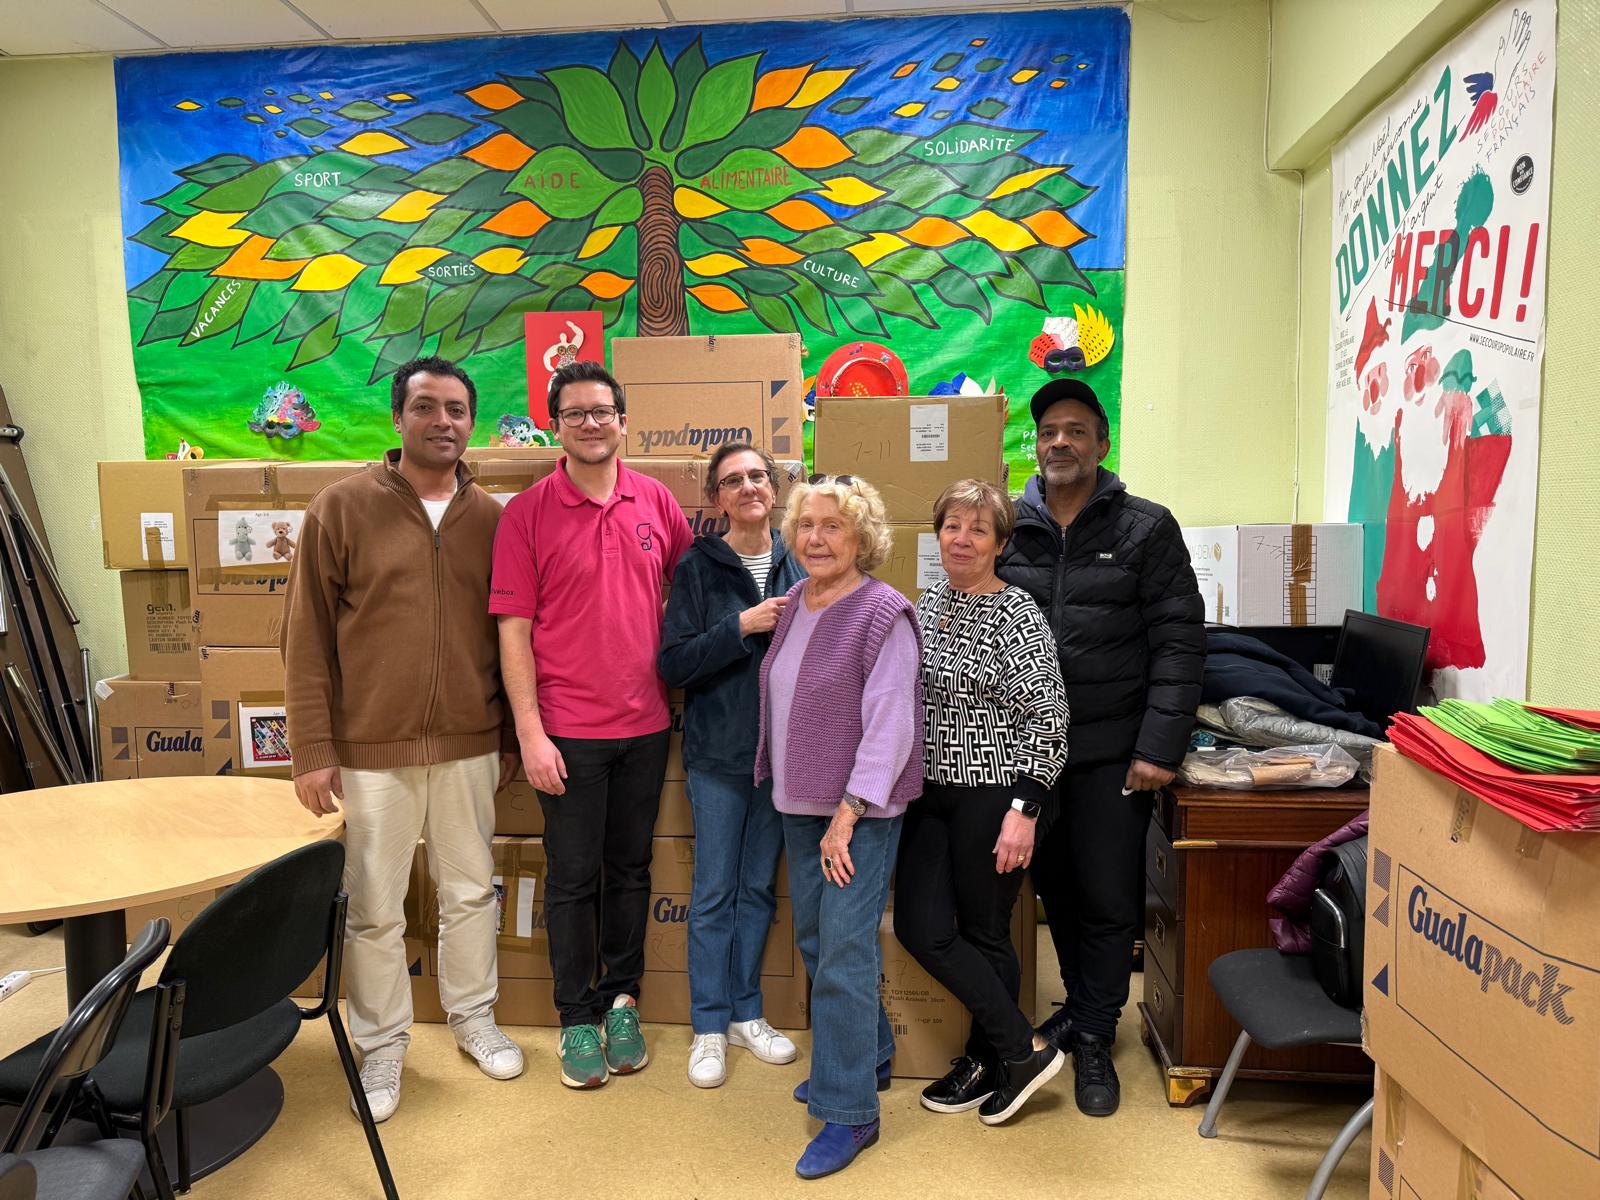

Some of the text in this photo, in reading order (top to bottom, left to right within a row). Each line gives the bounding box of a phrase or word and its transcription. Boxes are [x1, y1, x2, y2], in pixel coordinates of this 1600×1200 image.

[1477, 62, 1528, 154] SECOURS
[1486, 86, 1536, 163] FRANÇAIS
[1492, 51, 1546, 139] POPULAIRE
[294, 170, 341, 188] SPORT
[1336, 65, 1457, 315] DONNEZ
[191, 279, 241, 337] VACANCES
[803, 260, 860, 288] CULTURE
[1388, 225, 1511, 319] MERCI
[146, 730, 204, 757] Guala
[1408, 884, 1575, 1025] Gualapack
